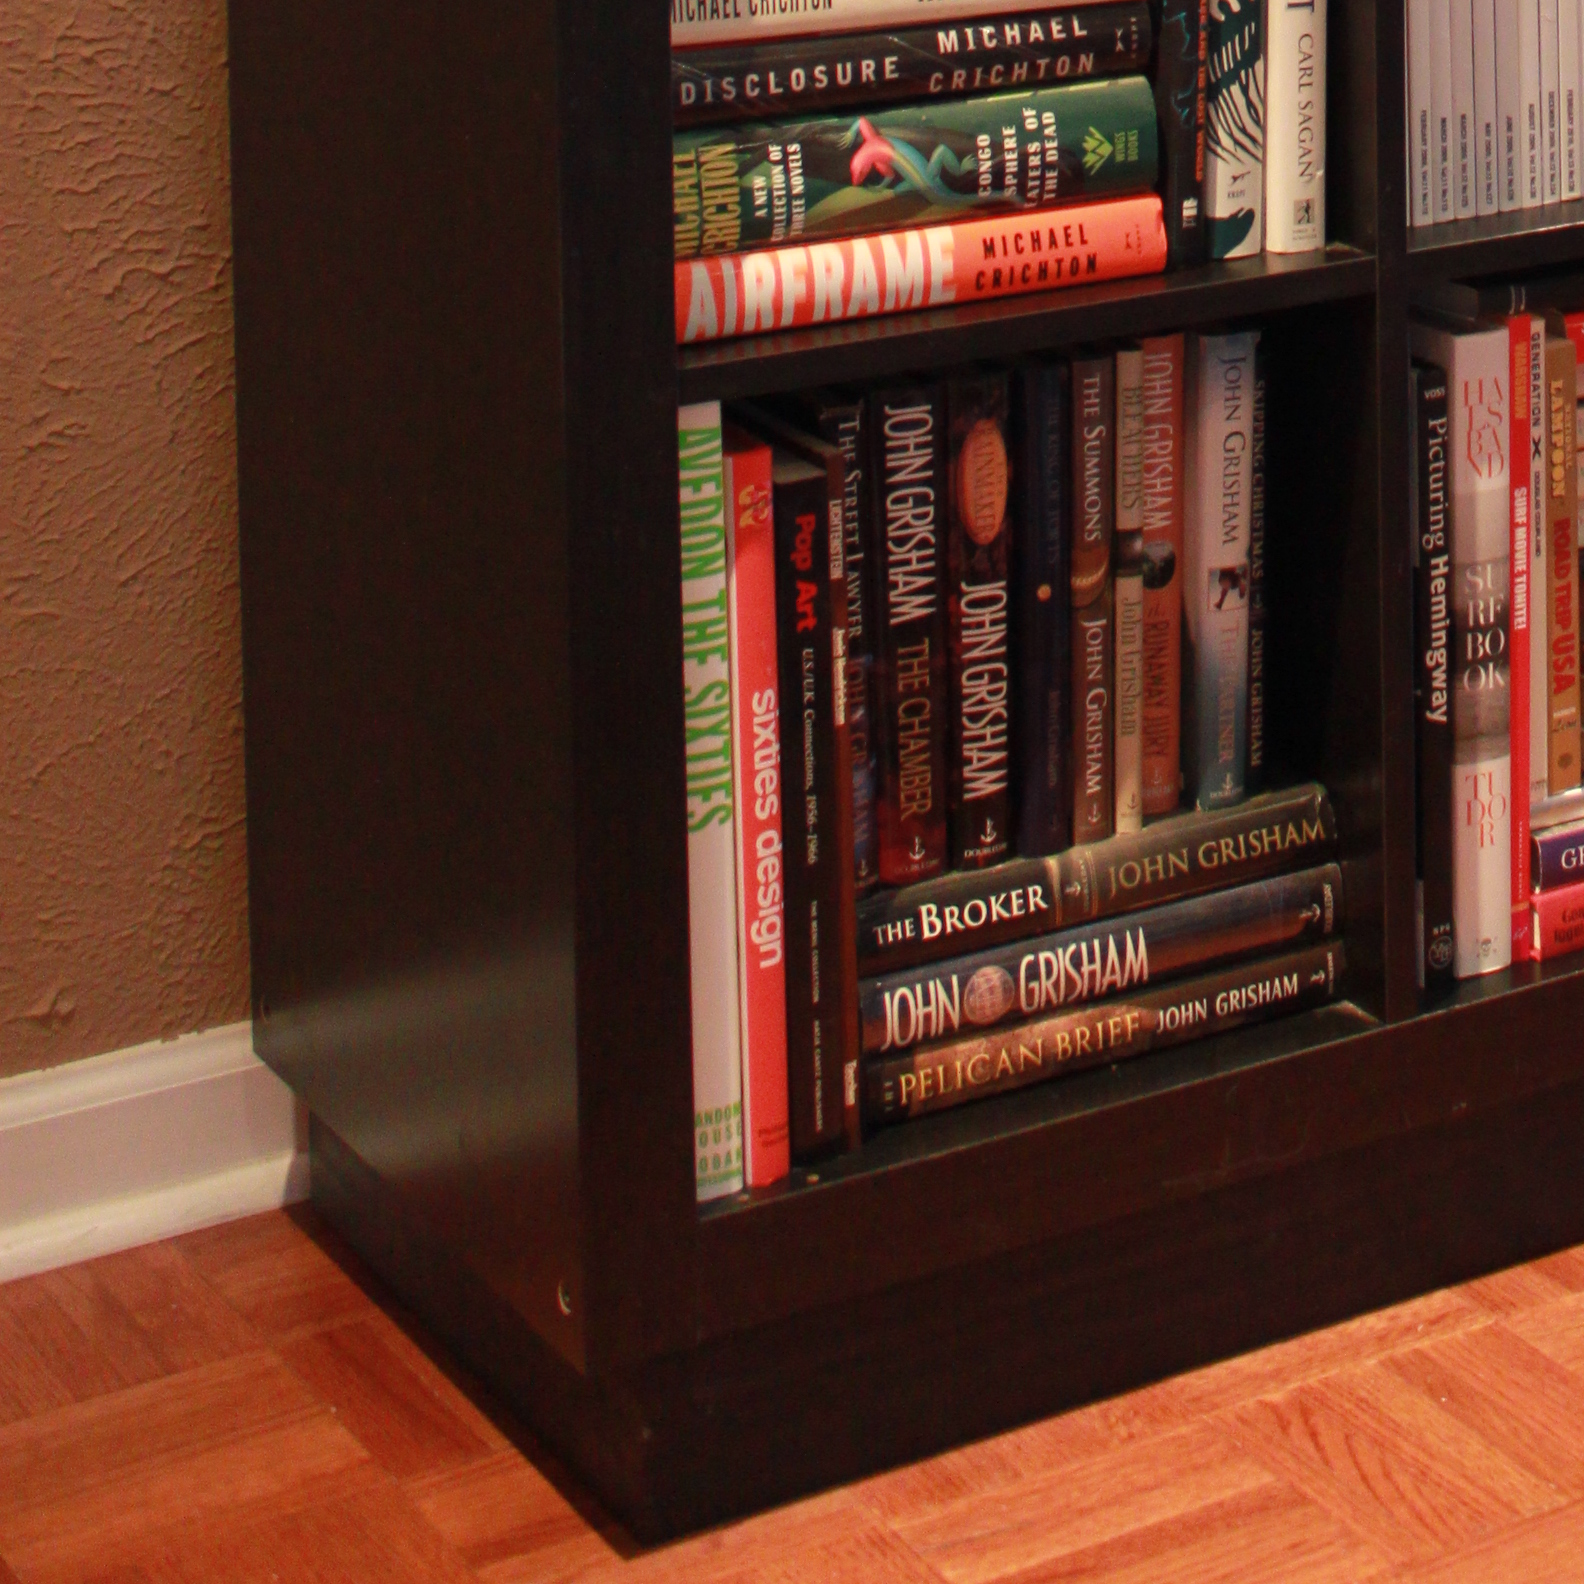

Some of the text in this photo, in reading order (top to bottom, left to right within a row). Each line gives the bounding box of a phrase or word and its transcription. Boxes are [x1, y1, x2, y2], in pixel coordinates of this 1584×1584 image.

[681, 16, 1095, 105] DISCLOSURE MICHAEL CRICHTON
[1298, 32, 1314, 90] CARL
[977, 134, 992, 197] CONGO
[1002, 125, 1018, 197] SPHERE
[1298, 99, 1314, 178] SAGAN
[684, 225, 956, 342] AIRFRAME
[976, 253, 1098, 292] CRICHTON
[982, 224, 1089, 260] MICHAEL
[1219, 356, 1246, 547] JOHN GRISHAM
[1513, 488, 1527, 528] SURF
[791, 513, 817, 632] Pop Art
[1421, 417, 1448, 724] Picturing Hemingway
[1513, 530, 1527, 575] MOVIE
[678, 427, 733, 836] AVEDON THE SIXTIES
[885, 405, 936, 820] JOHN GRISHAM THE CHAMBER
[961, 580, 1007, 801] JOHN GRISHAM
[752, 688, 784, 968] sixties design
[873, 818, 1326, 946] THE BROKER JOHN GRISHAM
[882, 927, 1148, 1051] JOHN GRISHAM
[900, 973, 1298, 1106] PELICAN BRIEF JOHN GRISHAM
